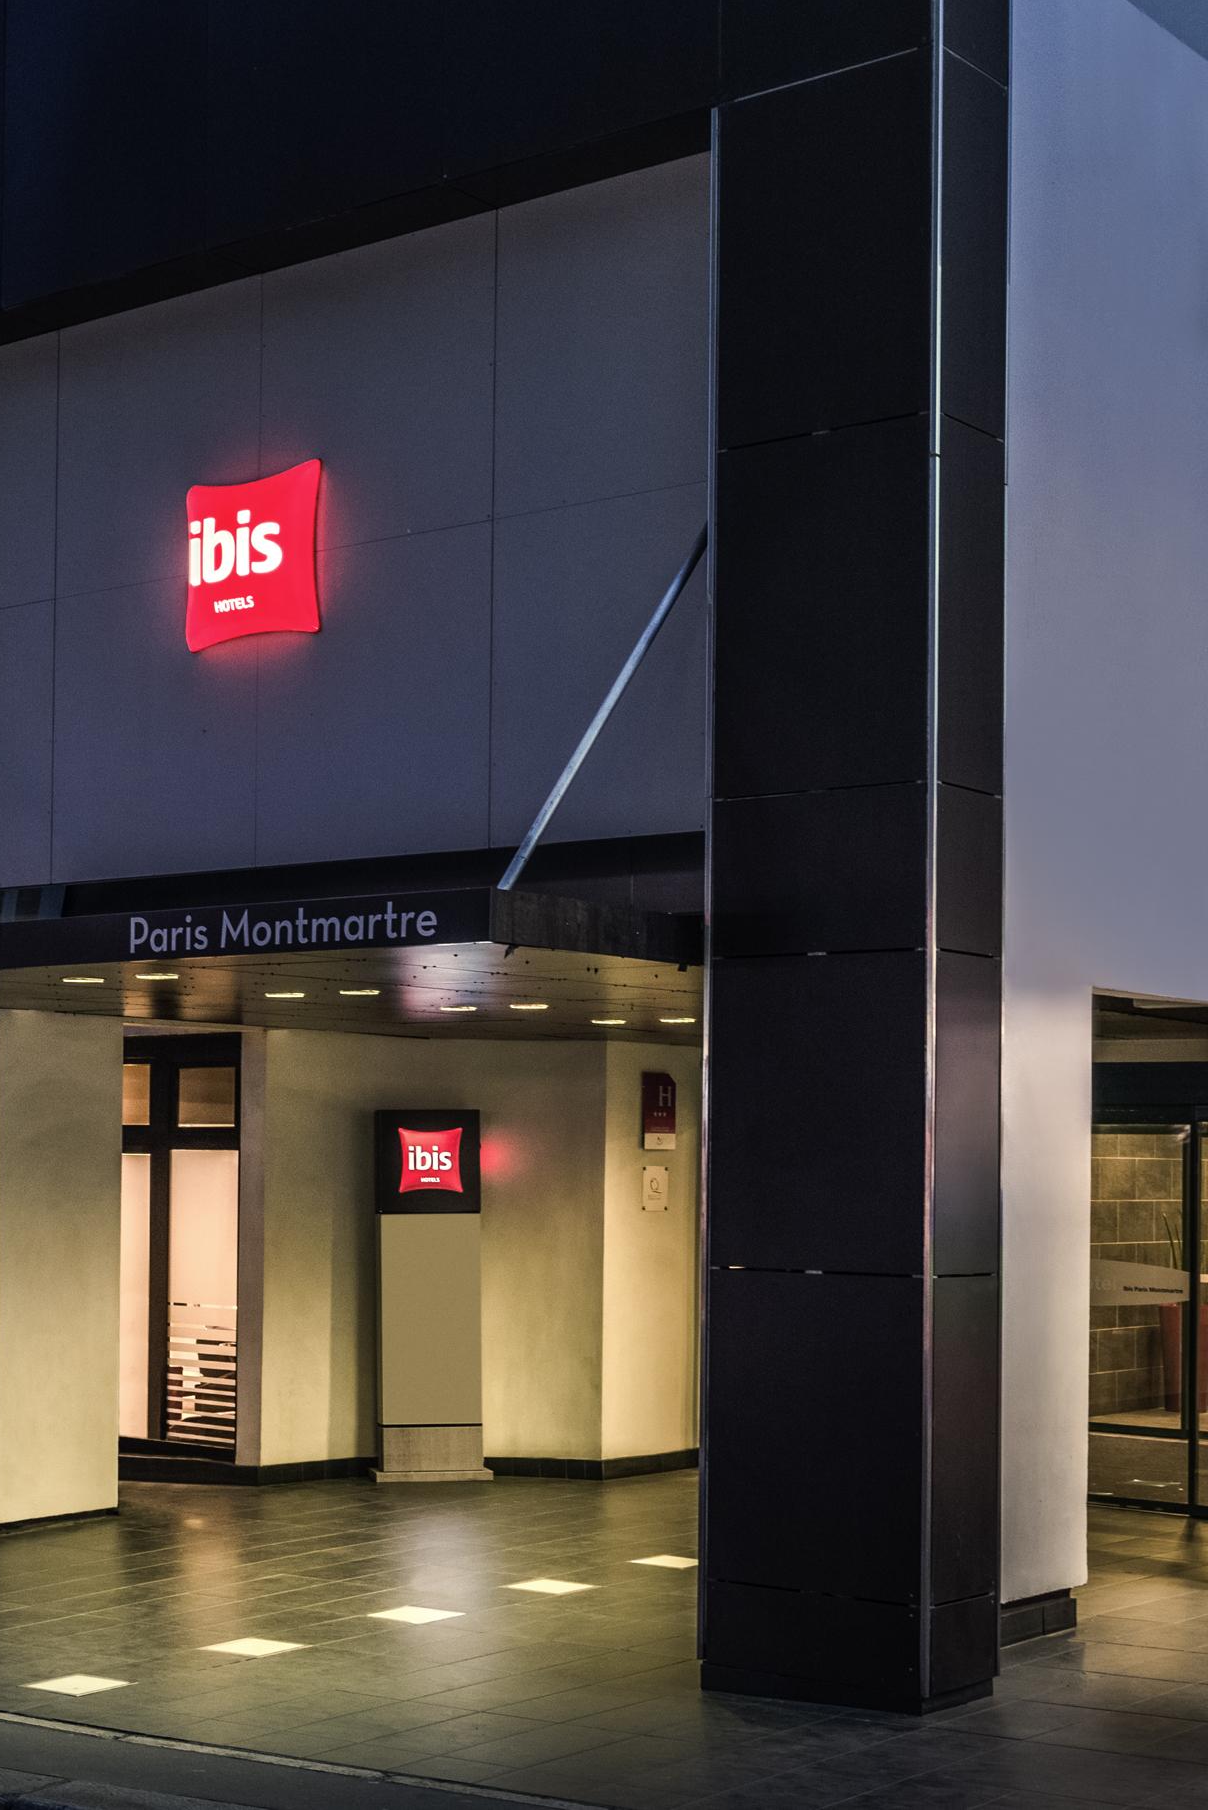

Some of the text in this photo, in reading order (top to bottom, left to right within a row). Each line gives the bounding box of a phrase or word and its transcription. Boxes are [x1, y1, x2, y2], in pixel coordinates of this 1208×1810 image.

[189, 509, 283, 587] ibis
[213, 595, 255, 614] HOTELS
[129, 901, 438, 954] Paris Montmartre
[658, 1085, 672, 1107] H
[408, 1145, 452, 1171] ibis
